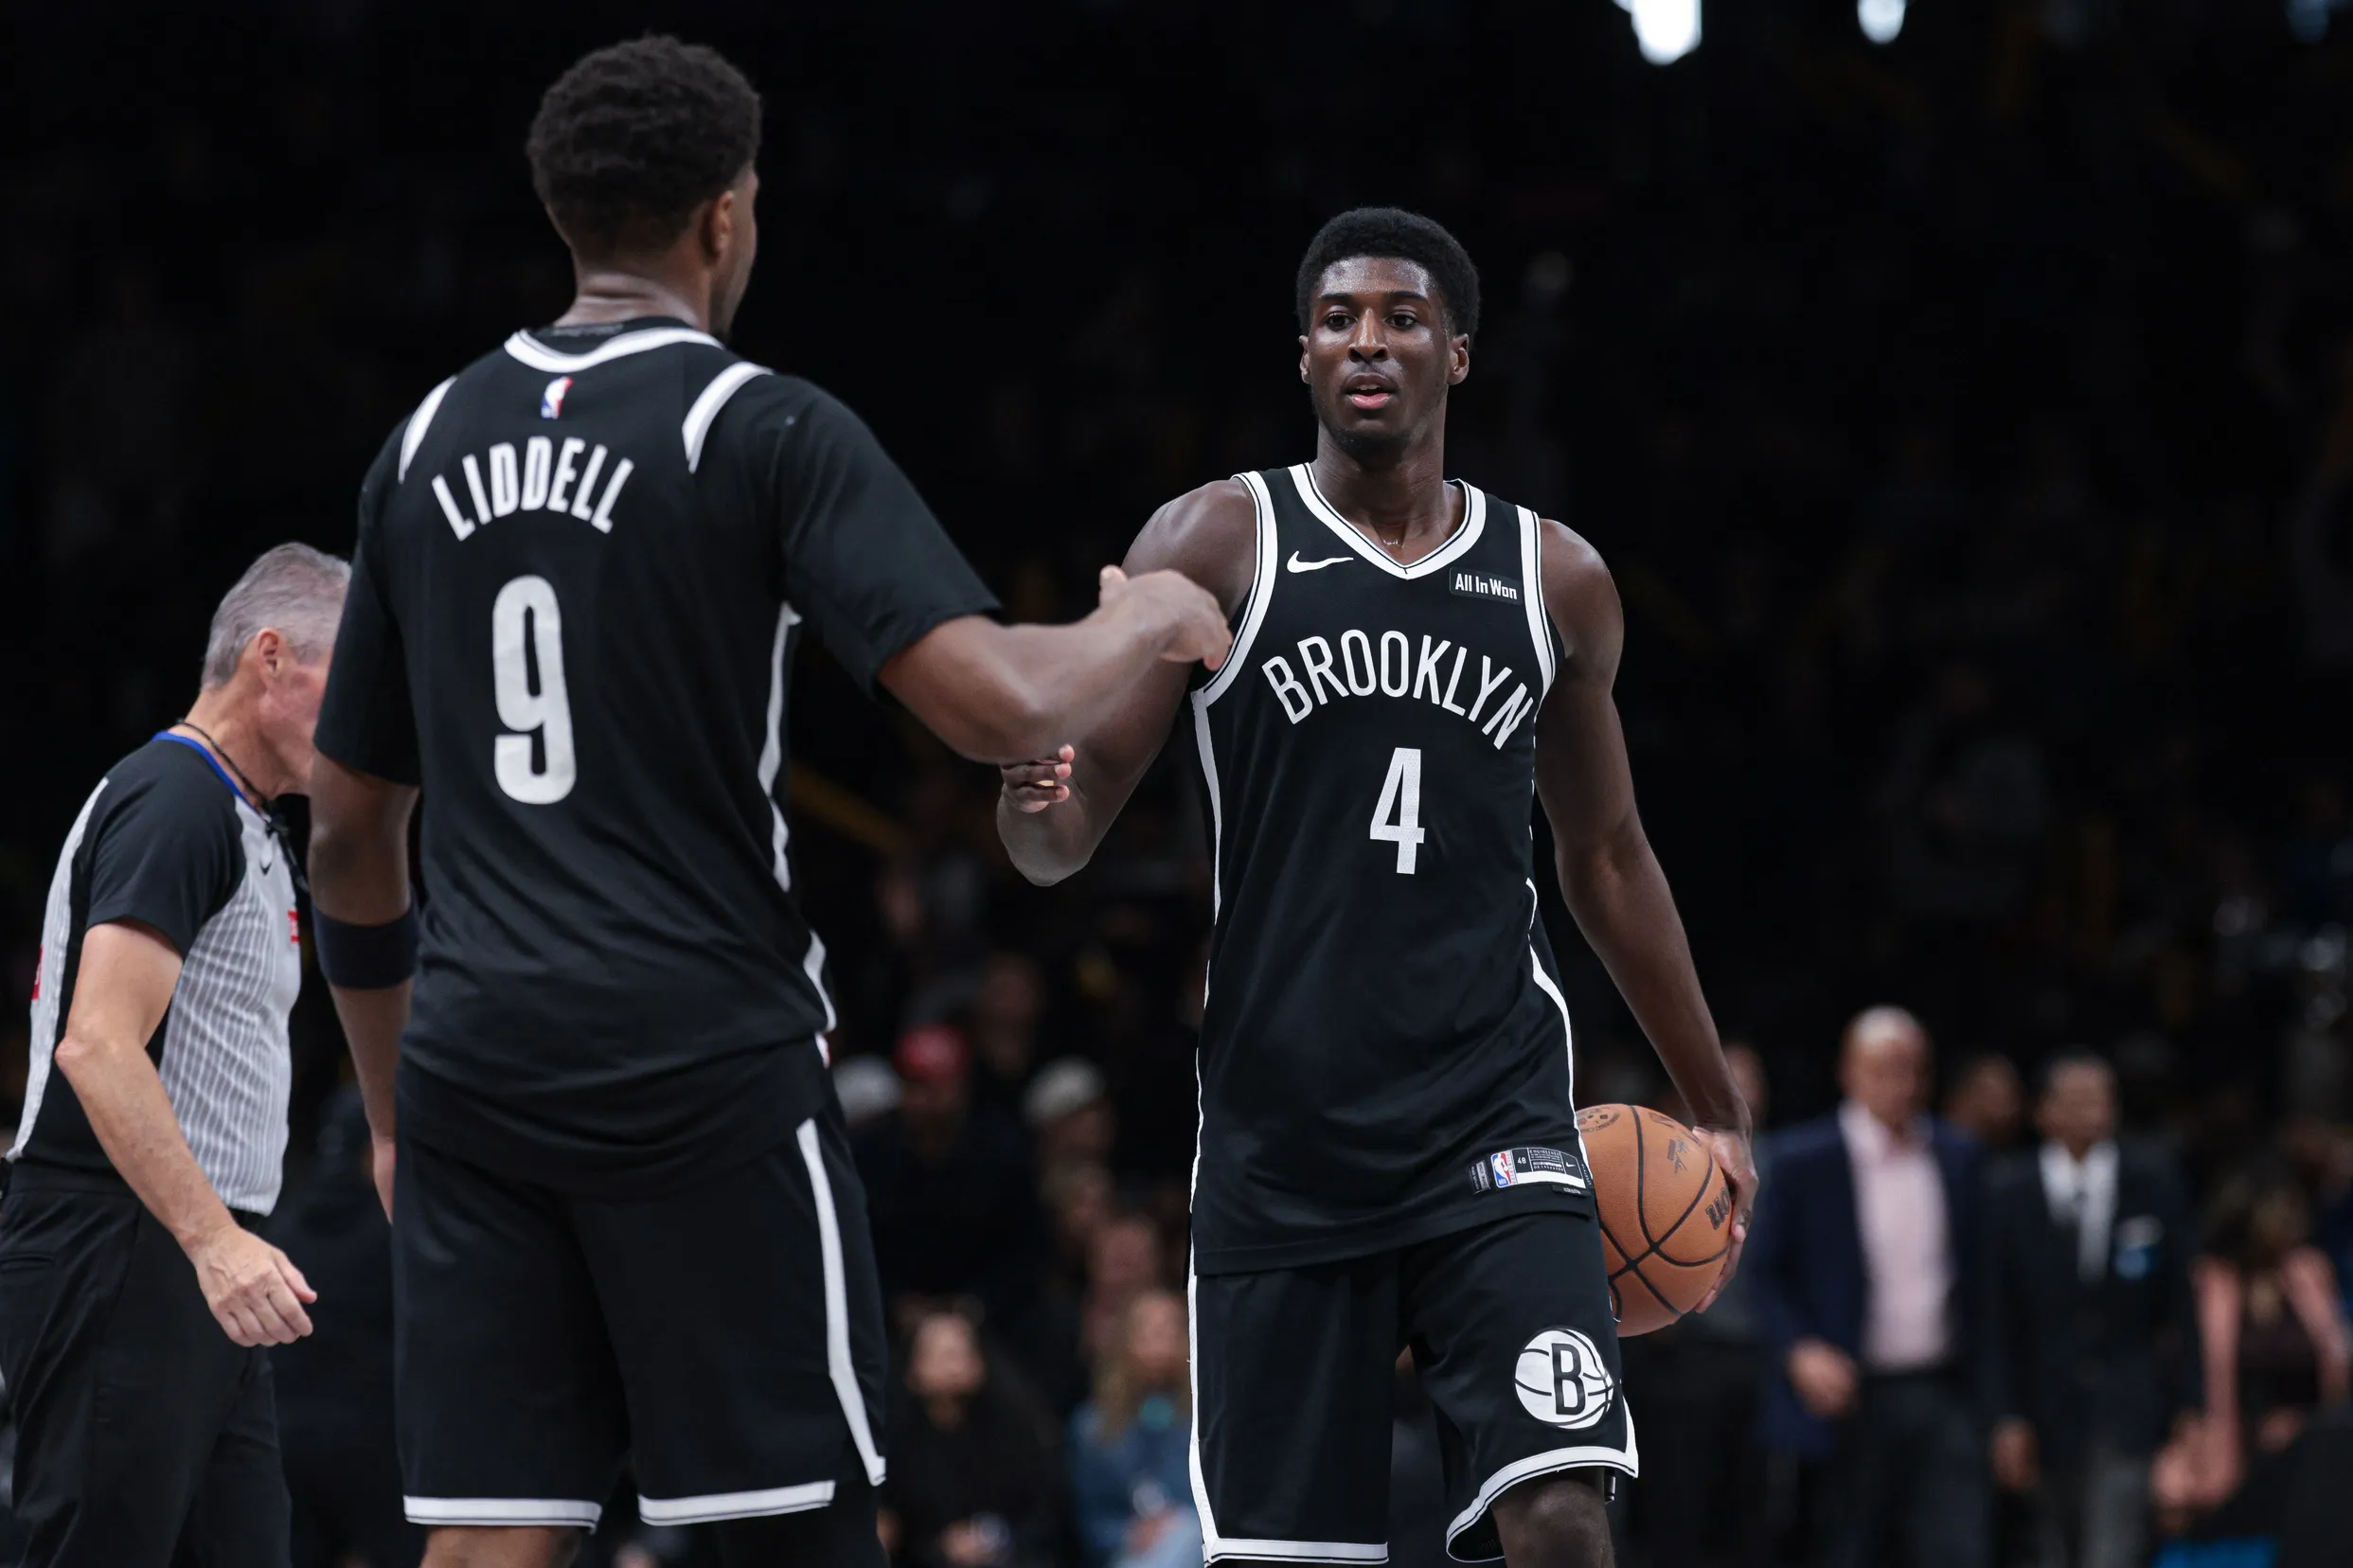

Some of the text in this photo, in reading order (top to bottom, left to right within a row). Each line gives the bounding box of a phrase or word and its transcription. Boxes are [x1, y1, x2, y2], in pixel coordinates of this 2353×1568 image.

[431, 436, 634, 542] LIDDELL
[1454, 573, 1518, 600] All In Won
[492, 575, 577, 805] 9
[1261, 629, 1534, 750] BROOKLYN
[1369, 746, 1426, 875] 4
[1551, 1343, 1586, 1416] B
